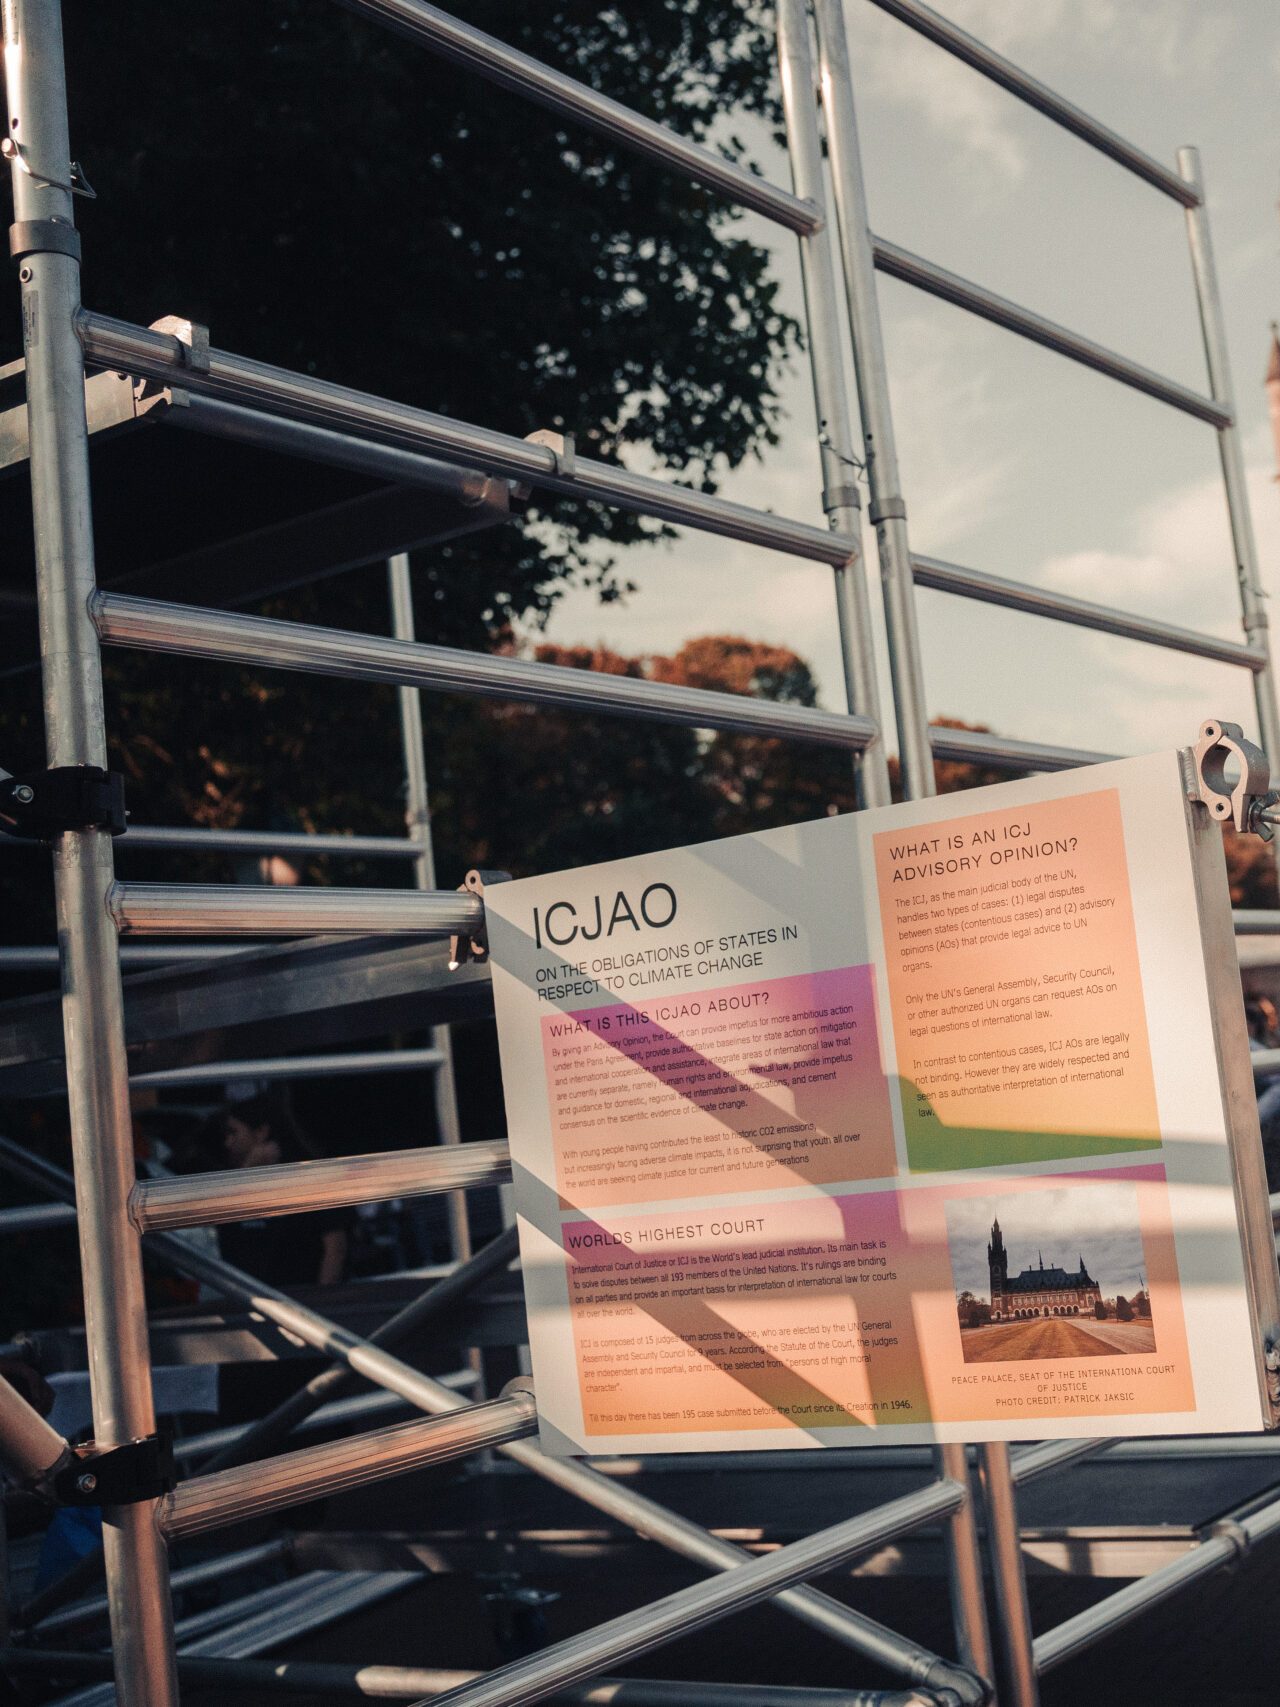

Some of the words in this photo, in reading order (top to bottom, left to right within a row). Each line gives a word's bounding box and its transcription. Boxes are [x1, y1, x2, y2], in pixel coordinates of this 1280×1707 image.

[889, 839, 940, 860] WHAT
[948, 835, 964, 850] IS
[972, 829, 996, 846] AN
[1004, 822, 1031, 839] ICJ
[893, 854, 982, 883] ADVISORY
[990, 837, 1078, 865] OPINION?
[895, 898, 911, 907] The
[930, 894, 940, 902] as
[942, 891, 955, 900] the
[957, 887, 978, 897] main
[980, 880, 1009, 896] judicial
[1011, 877, 1032, 888] body
[1034, 874, 1042, 884] of
[1044, 873, 1058, 882] the
[897, 912, 929, 924] handles
[930, 909, 945, 918] two
[947, 905, 969, 917] types
[971, 902, 979, 912] of
[1011, 894, 1024, 907] (1)
[1026, 891, 1046, 903] legal
[1049, 886, 1085, 899] disputes
[533, 883, 677, 949] ICJAO
[898, 928, 932, 940] between
[934, 924, 959, 934] states
[961, 915, 1012, 932] (contentious
[1014, 908, 1043, 921] cases)
[1045, 905, 1062, 916] and
[1064, 902, 1077, 915] (2)
[1080, 898, 1115, 911] advisory
[536, 967, 557, 983] ON
[560, 961, 587, 978] THE
[592, 944, 690, 973] OBLIGATIONS
[694, 939, 714, 955] OF
[719, 928, 777, 951] STATES
[782, 925, 798, 940] IN
[900, 944, 934, 957] opinions
[936, 938, 959, 952] (AOs)
[961, 936, 978, 946] that
[979, 931, 1009, 945] provide
[1011, 927, 1031, 939] legal
[1033, 924, 1061, 935] advice
[1063, 922, 1072, 930] to
[1074, 918, 1087, 929] UN
[537, 979, 600, 1001] RESPECT
[604, 975, 625, 989] TO
[628, 963, 693, 987] CLIMATE
[697, 951, 763, 975] CHANGE
[905, 994, 924, 1005] Only
[925, 993, 939, 1001] the
[963, 983, 995, 996] General
[1042, 972, 1077, 984] Security
[549, 1019, 591, 1037] WHAT
[597, 1017, 611, 1030] IS
[616, 1011, 649, 1027] THIS
[656, 1003, 701, 1021] ICJAO
[708, 992, 769, 1013] ABOUT?
[907, 1012, 916, 1021] or
[918, 1009, 938, 1019] other
[941, 1001, 984, 1016] authorized
[986, 999, 999, 1009] UN
[1001, 996, 1031, 1008] organs
[1032, 993, 1049, 1002] can
[1051, 987, 1084, 1000] request
[1086, 984, 1104, 995] AOs
[1106, 983, 1117, 992] on
[909, 1025, 929, 1037] legal
[930, 1021, 970, 1035] questions
[971, 1018, 979, 1028] of
[981, 1011, 1033, 1026] international
[913, 1059, 922, 1069] In
[923, 1055, 957, 1068] contrast
[958, 1054, 967, 1063] to
[968, 1048, 1017, 1062] contentious
[1049, 1040, 1062, 1052] ICJ
[1065, 1038, 1083, 1048] AOs
[1085, 1037, 1099, 1046] are
[1102, 1032, 1130, 1045] legally
[915, 1075, 928, 1084] not
[964, 1067, 999, 1078] However
[1002, 1065, 1020, 1074] they
[1022, 1063, 1036, 1071] are
[1038, 1058, 1065, 1069] widely
[1067, 1052, 1110, 1066] respected
[1112, 1049, 1130, 1060] and
[938, 1090, 949, 1099] as
[951, 1084, 1001, 1097] authoritative
[1003, 1077, 1058, 1090] interpretation
[1060, 1074, 1068, 1084] of
[1070, 1067, 1124, 1082] international
[568, 1232, 632, 1248] WORLDS
[638, 1224, 703, 1242] HIGHEST
[710, 1219, 764, 1236] COURT
[571, 1264, 613, 1275] International
[614, 1262, 634, 1271] Court
[634, 1260, 641, 1269] of
[643, 1259, 667, 1269] Justice
[668, 1259, 676, 1267] or
[677, 1256, 689, 1266] ICJ
[691, 1256, 698, 1264] is
[698, 1256, 710, 1264] the
[742, 1250, 758, 1260] lead
[759, 1248, 785, 1260] judicial
[827, 1244, 838, 1253] Its
[839, 1243, 859, 1251] main
[860, 1240, 877, 1250] task
[879, 1240, 887, 1248] is
[952, 1375, 978, 1384] PEACE
[981, 1373, 1017, 1383] PALACE,
[1019, 1372, 1040, 1381] SEAT
[1043, 1371, 1054, 1380] OF
[1058, 1370, 1075, 1379] THE
[1078, 1367, 1143, 1378] INTERNATIONA
[1146, 1365, 1175, 1374] COURT
[1037, 1384, 1048, 1393] OF
[1052, 1382, 1087, 1392] JUSTICE
[996, 1397, 1024, 1406] PHOTO
[1026, 1396, 1061, 1405] CREDIT:
[1064, 1394, 1101, 1403] PATRICK
[1104, 1392, 1134, 1402] JAKSIC
